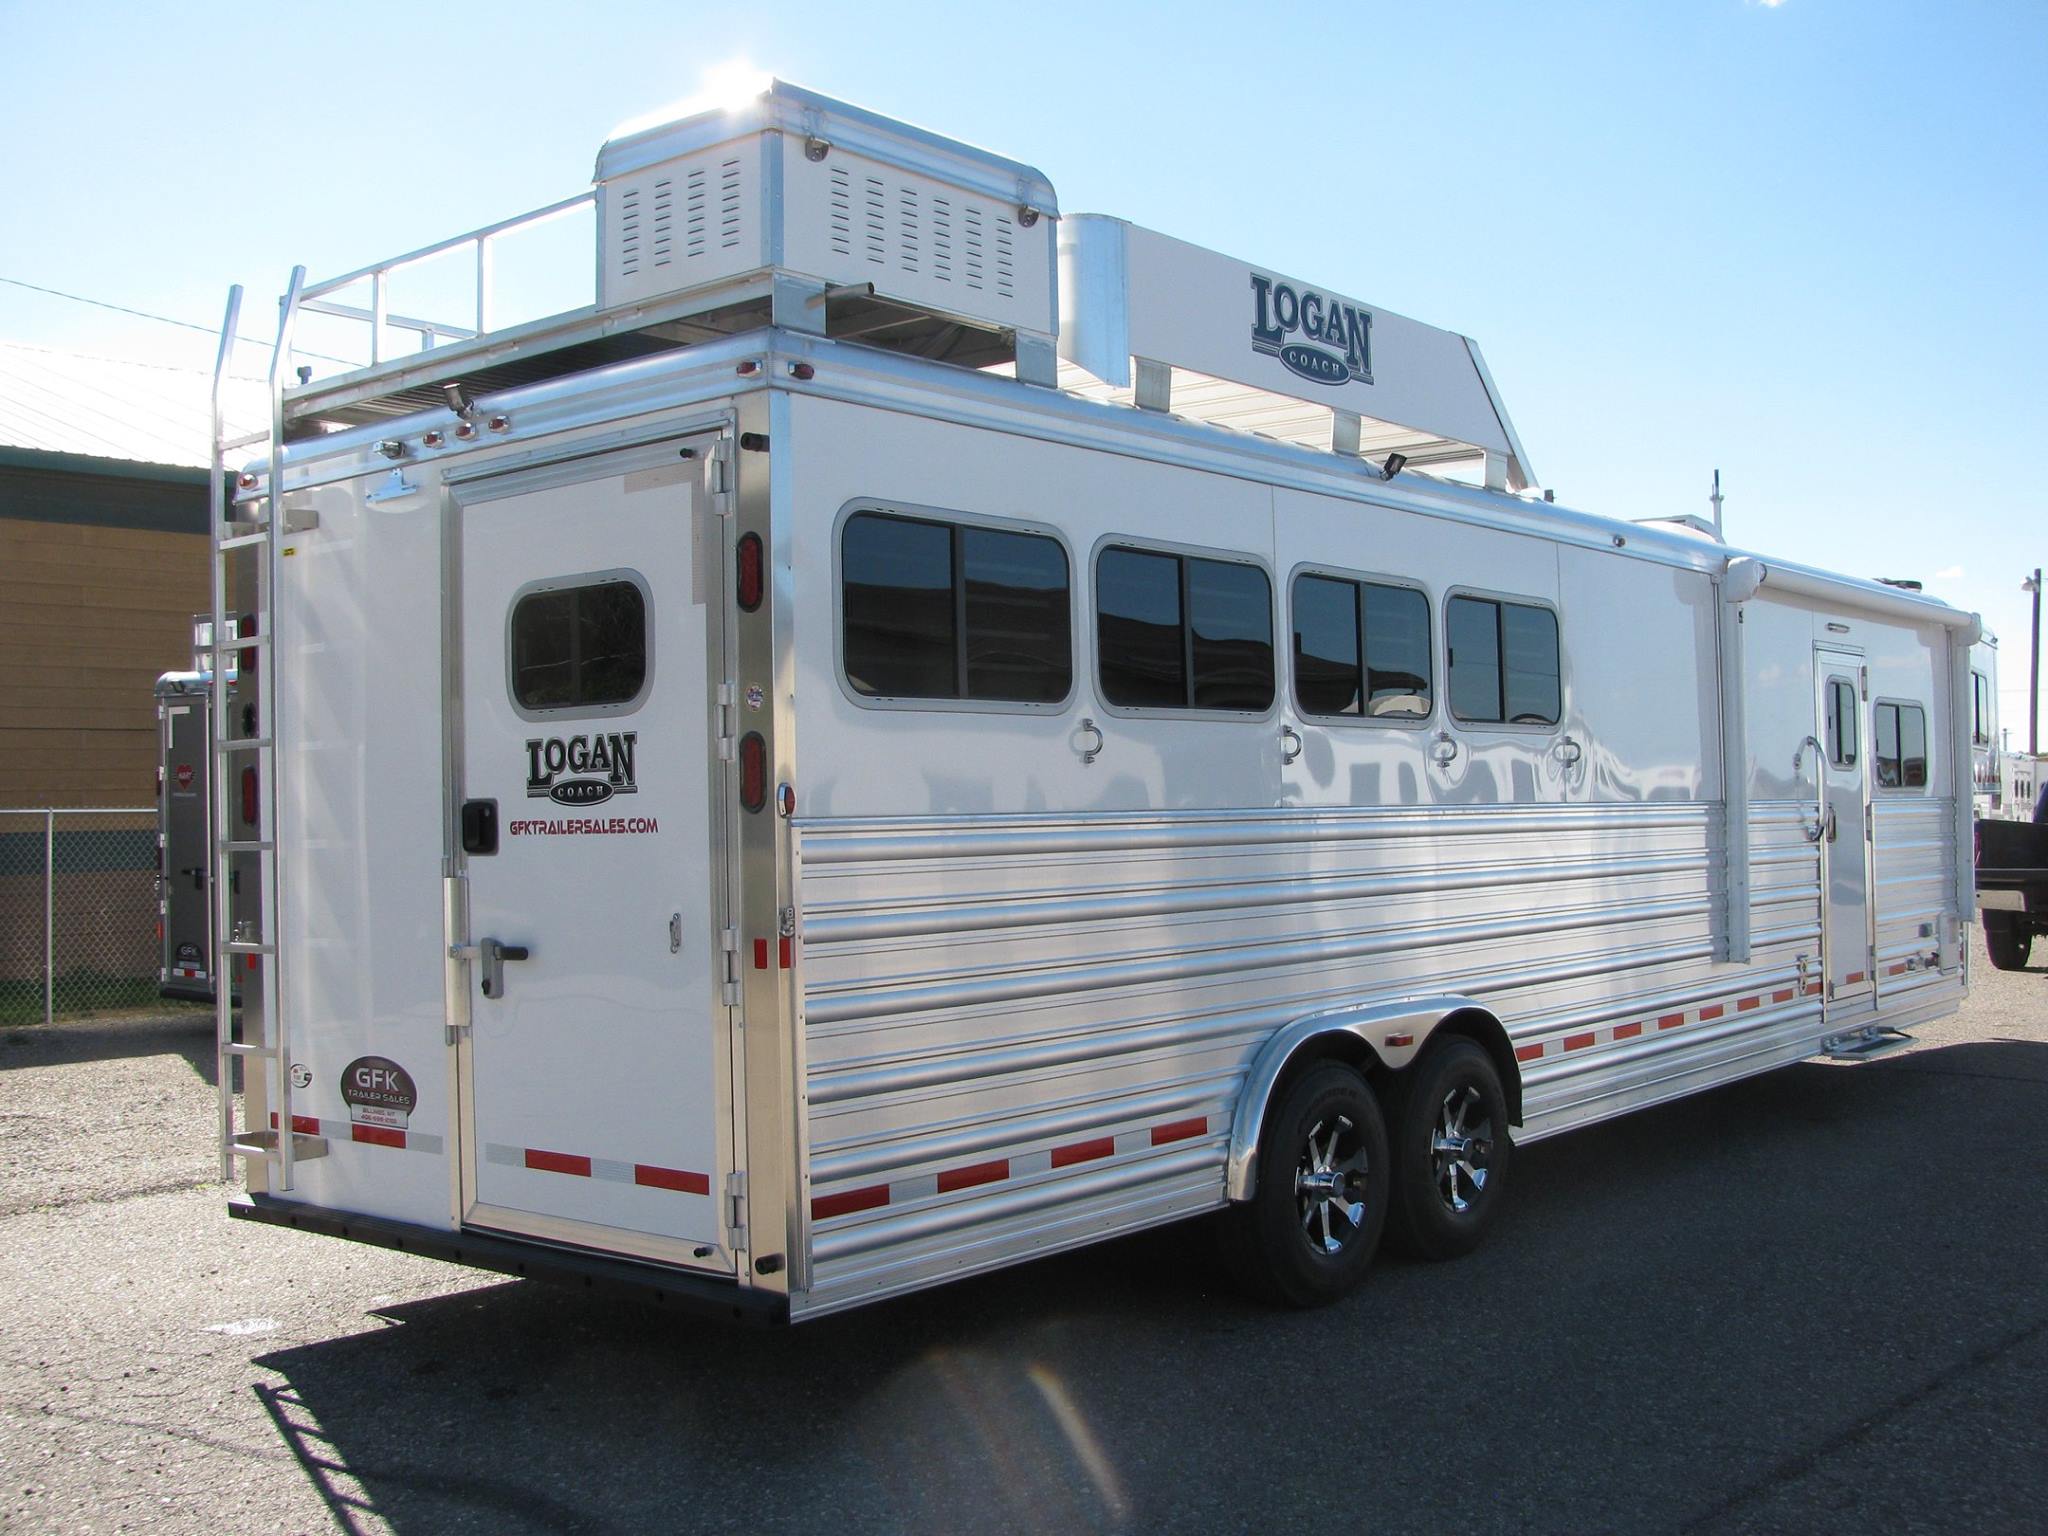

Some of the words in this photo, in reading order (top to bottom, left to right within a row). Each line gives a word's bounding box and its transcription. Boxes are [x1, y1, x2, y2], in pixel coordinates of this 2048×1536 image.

[1250, 272, 1373, 376] LOGAN
[1289, 351, 1340, 376] COACH
[526, 731, 638, 789] LOGAN
[557, 786, 604, 797] COACH
[509, 817, 659, 836] GFKTRAILERSALES.COM
[355, 1067, 400, 1092] GFK
[348, 1088, 381, 1100] TRAILER
[382, 1094, 411, 1105] SALES
